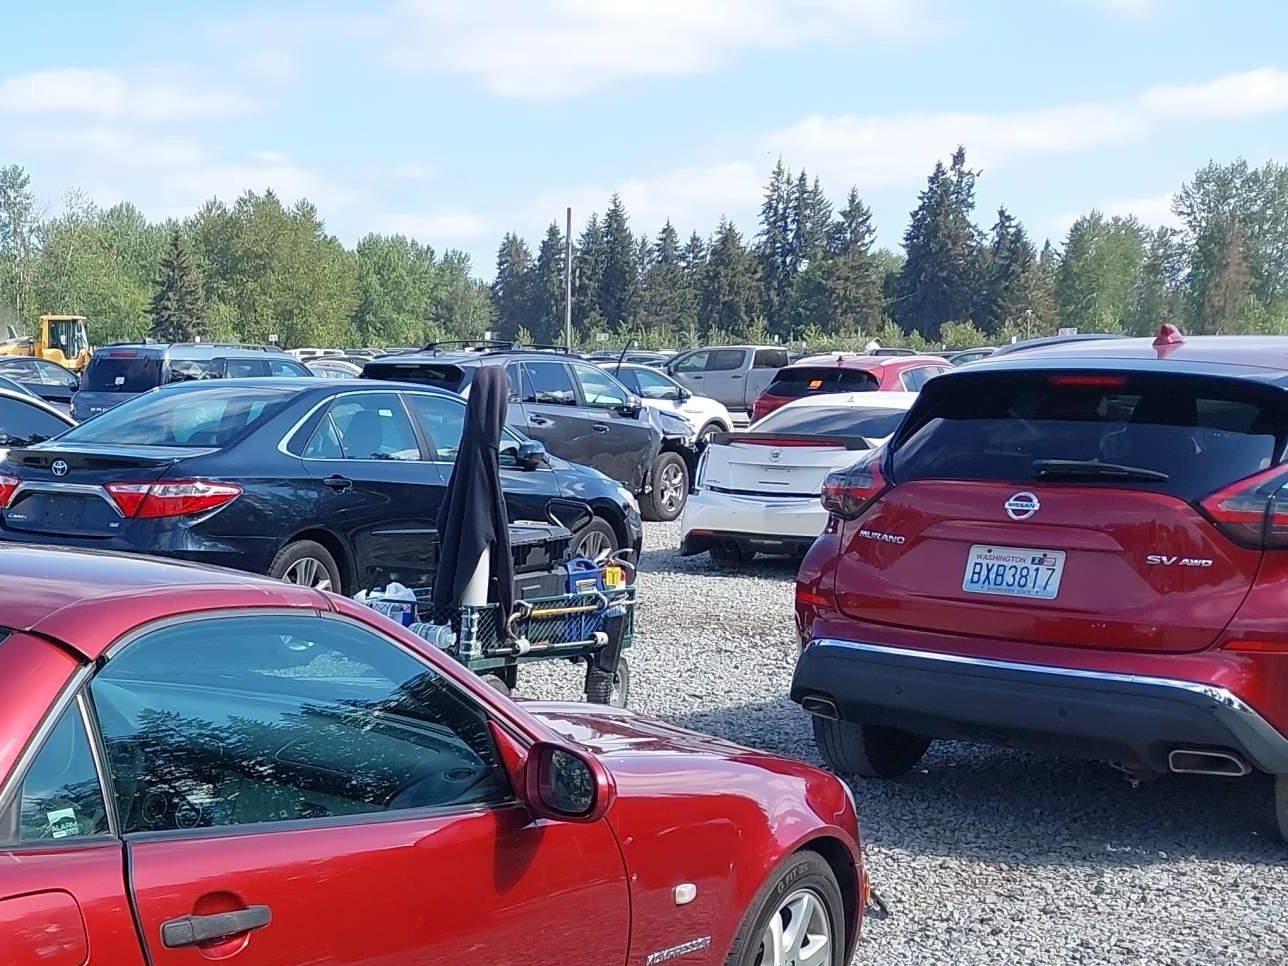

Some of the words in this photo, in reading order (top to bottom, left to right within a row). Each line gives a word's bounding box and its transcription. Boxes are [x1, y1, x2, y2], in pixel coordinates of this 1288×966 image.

[859, 530, 905, 544] MURANO
[976, 553, 1026, 564] WASHINGTON
[1146, 555, 1178, 566] SV
[1179, 558, 1213, 567] AWD
[970, 562, 1055, 590] BXB3817
